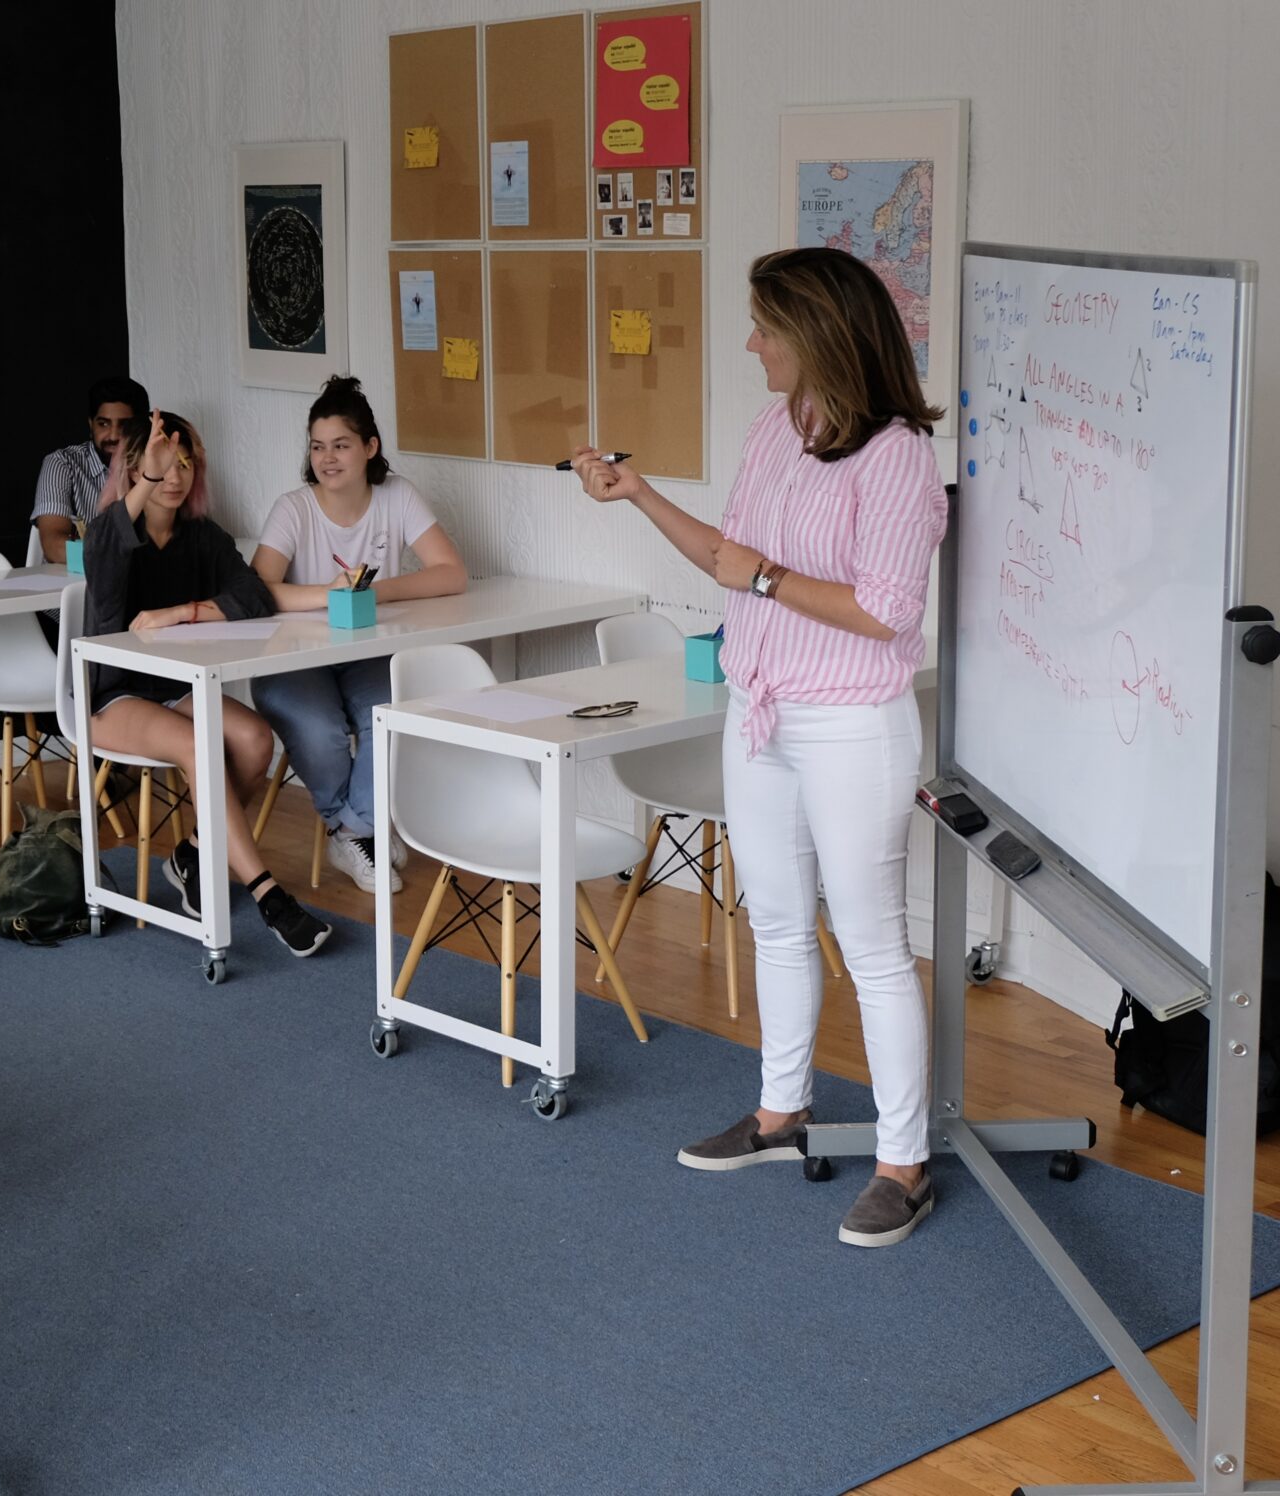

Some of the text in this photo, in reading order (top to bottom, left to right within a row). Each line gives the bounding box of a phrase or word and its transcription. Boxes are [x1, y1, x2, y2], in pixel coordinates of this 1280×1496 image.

[802, 200, 844, 212] EUROPE
[1043, 284, 1120, 334] GEOMETRY
[1169, 341, 1213, 377] Saturday
[1024, 352, 1125, 418] ALL ANGLES IN A
[1033, 400, 1073, 433] TRIANGLE
